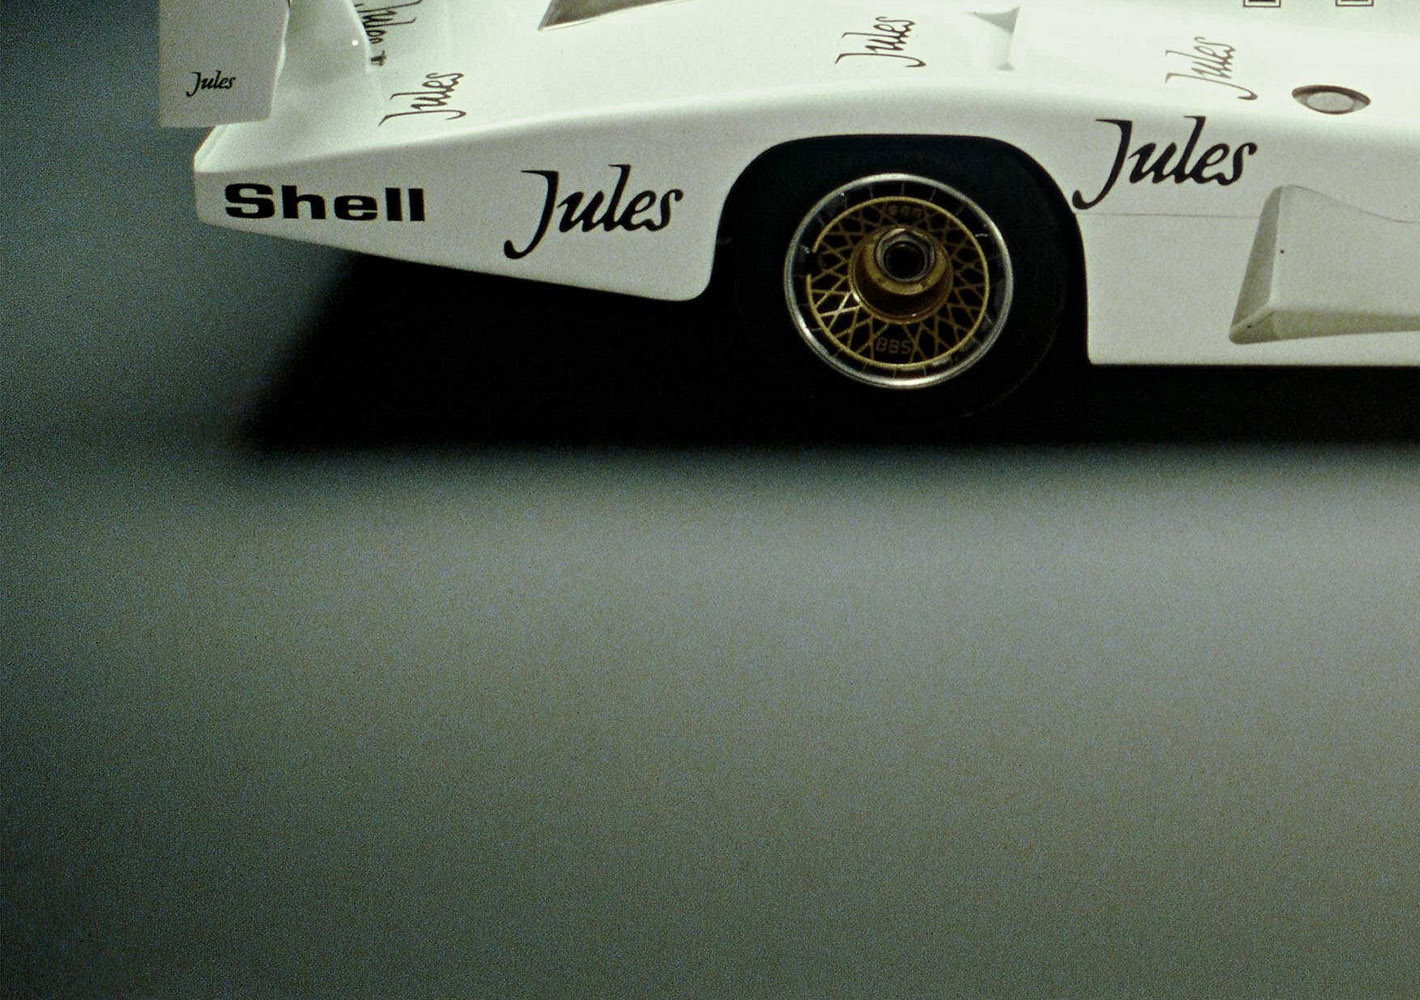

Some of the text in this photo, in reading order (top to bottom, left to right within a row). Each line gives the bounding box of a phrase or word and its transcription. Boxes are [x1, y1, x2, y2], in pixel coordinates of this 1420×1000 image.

[834, 15, 926, 68] Jules
[1164, 36, 1258, 101] Jules
[186, 70, 236, 98] Jules
[378, 71, 468, 127] Jules
[1072, 114, 1258, 211] Jules
[223, 182, 427, 223] Shell
[502, 163, 685, 260] Jules
